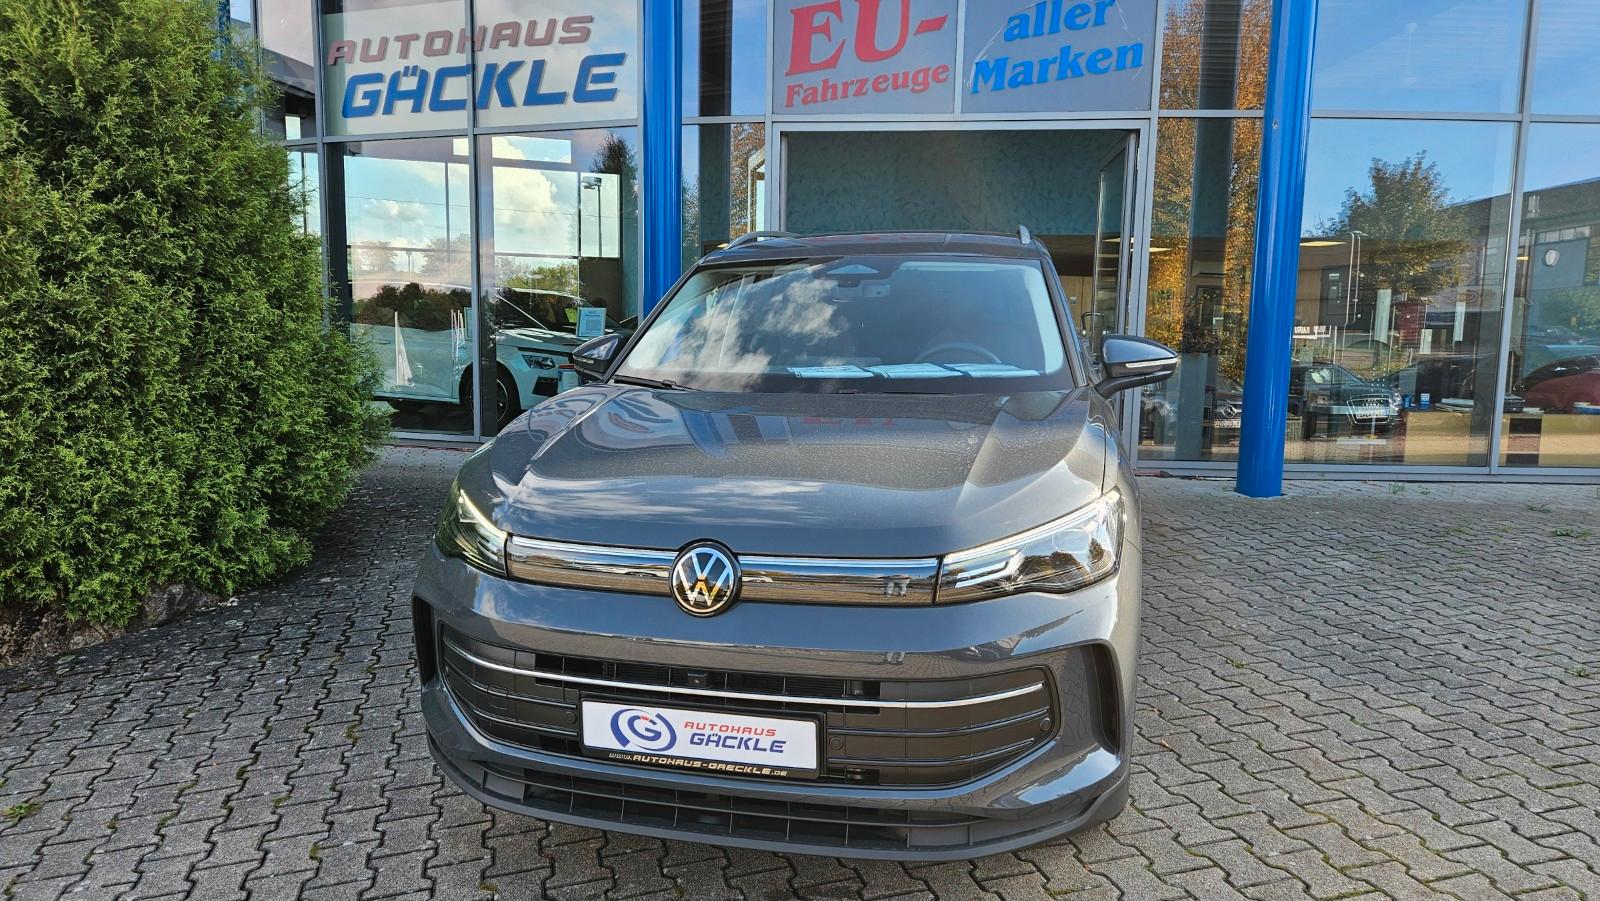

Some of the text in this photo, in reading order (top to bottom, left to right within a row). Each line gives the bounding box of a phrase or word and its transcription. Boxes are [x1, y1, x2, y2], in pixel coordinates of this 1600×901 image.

[328, 15, 595, 66] AUTOHAUS
[784, 0, 948, 77] EU-
[1003, 0, 1118, 43] aller
[341, 52, 626, 119] GÄCKLE
[784, 63, 951, 108] Fahrzeuge
[970, 41, 1144, 95] Marken
[684, 721, 777, 738] AUTOHAUS
[689, 732, 787, 754] GÄCKLE
